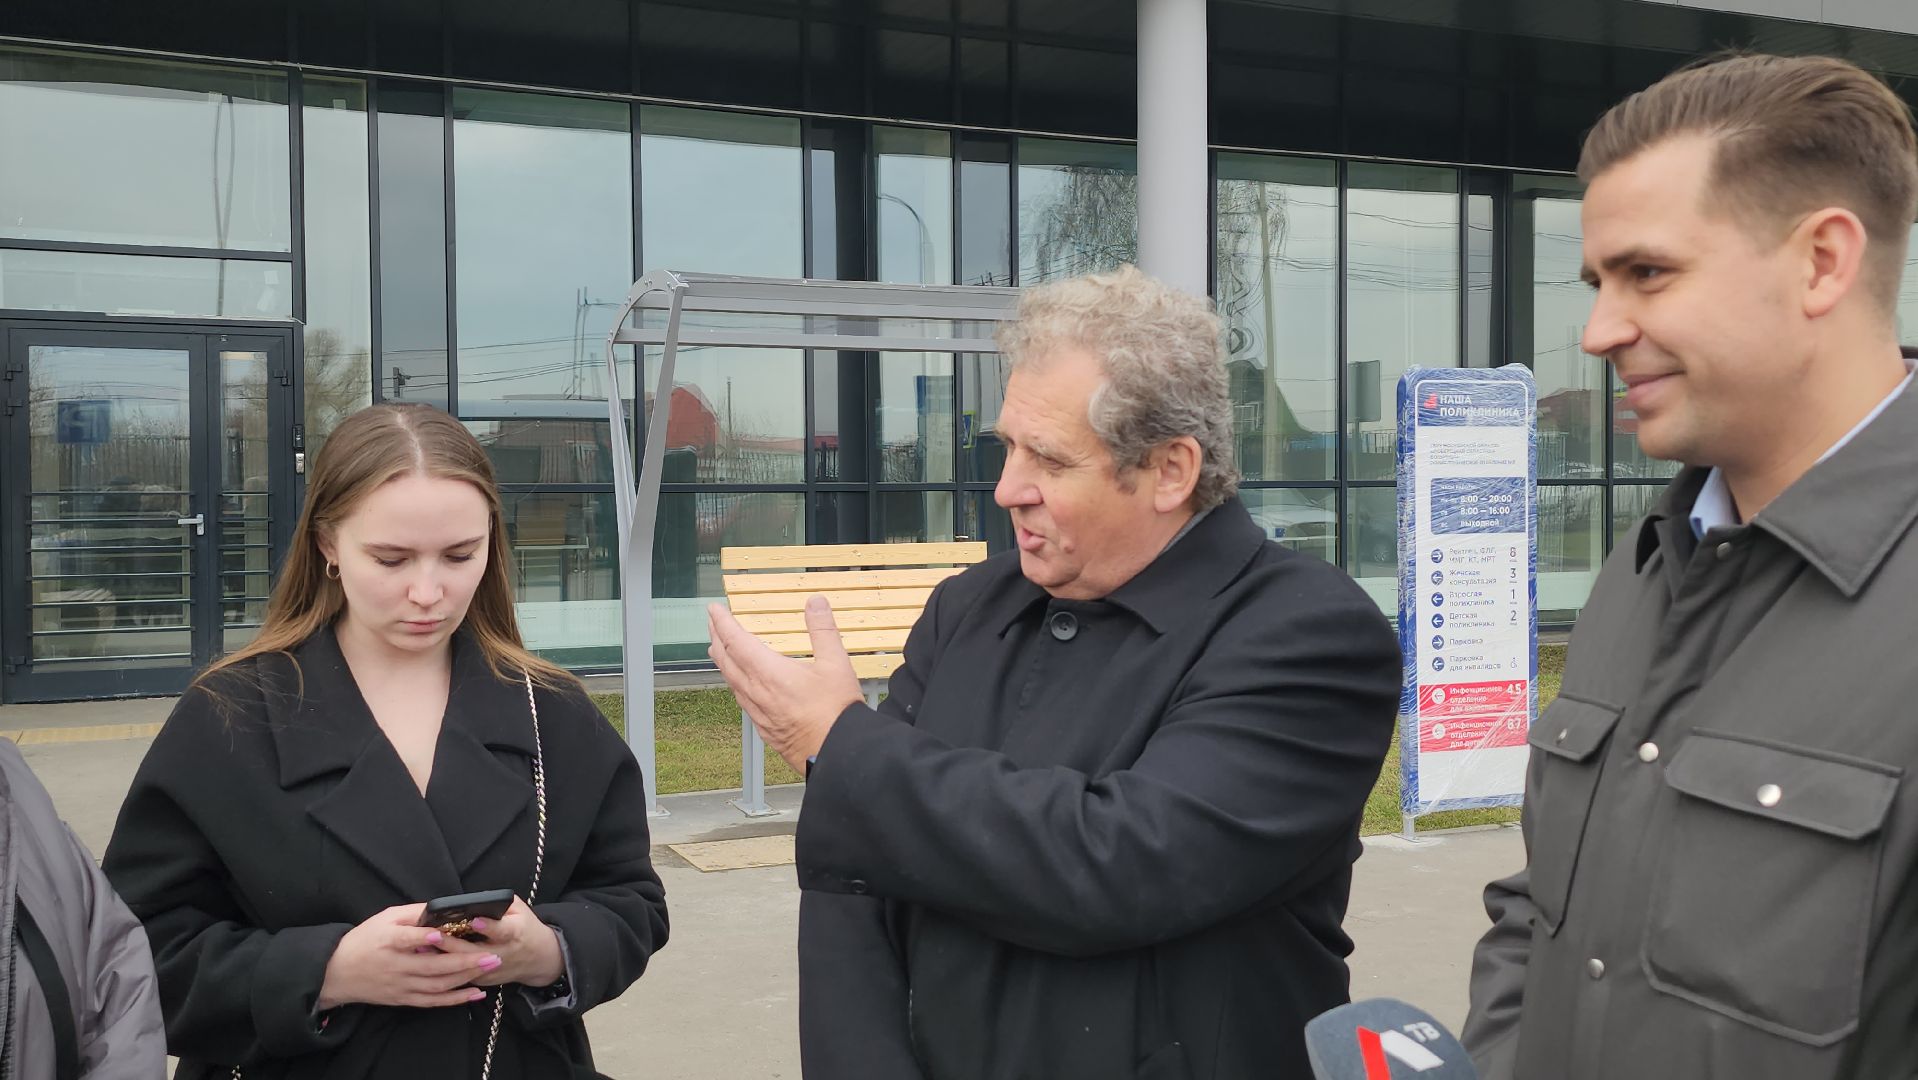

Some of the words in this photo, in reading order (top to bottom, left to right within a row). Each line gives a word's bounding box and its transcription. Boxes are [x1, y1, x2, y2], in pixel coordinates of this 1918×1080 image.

[1440, 394, 1472, 405] НАША
[1440, 407, 1520, 417] ПОЛИКЛИНИКА
[1460, 495, 1478, 503] 8:00
[1489, 494, 1512, 502] 20:00
[1460, 507, 1478, 515] 8:00
[1489, 506, 1510, 514] 16:00
[1510, 547, 1516, 557] 8
[1510, 568, 1516, 578] 3
[1511, 589, 1515, 599] 1
[1511, 610, 1517, 621] 2
